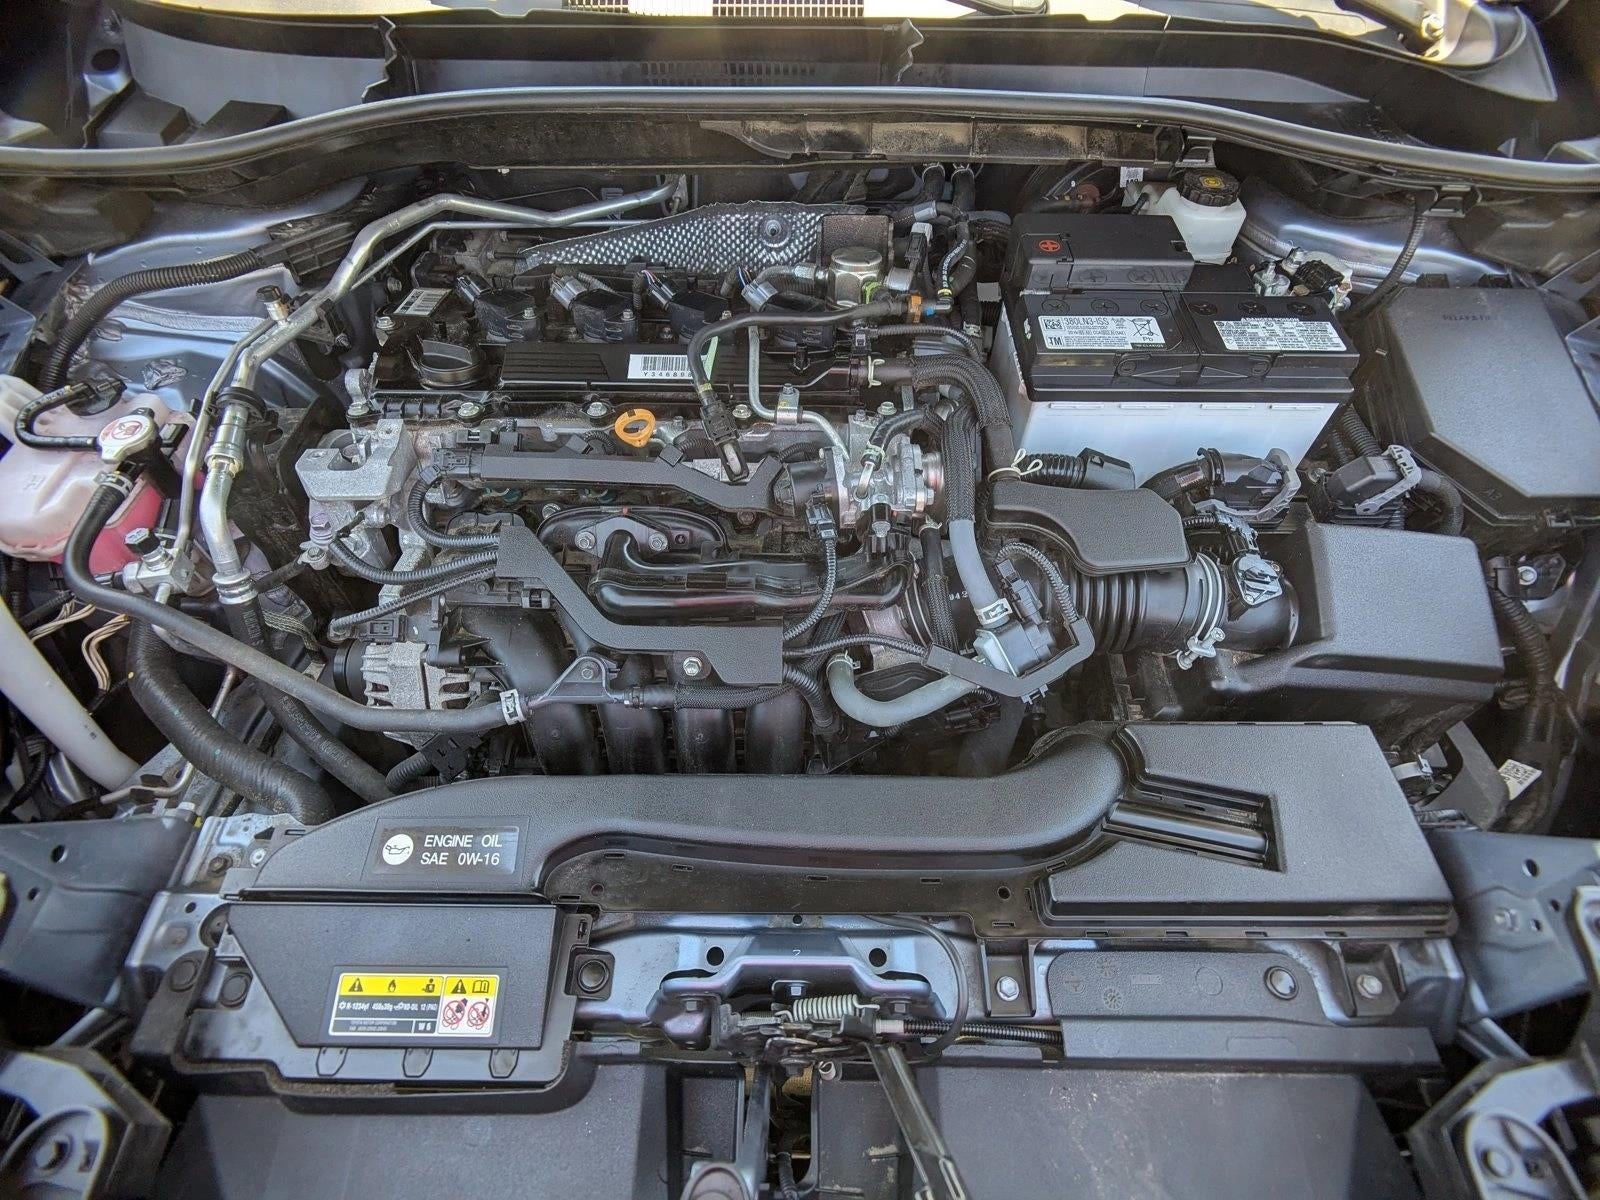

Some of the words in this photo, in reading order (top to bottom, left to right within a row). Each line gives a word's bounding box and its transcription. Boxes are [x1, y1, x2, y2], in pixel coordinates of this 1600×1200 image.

[1048, 336, 1062, 346] TM
[424, 834, 473, 847] ENGINE
[481, 834, 502, 847] OIL
[420, 852, 449, 865] SAE
[457, 852, 500, 865] 0W-16
